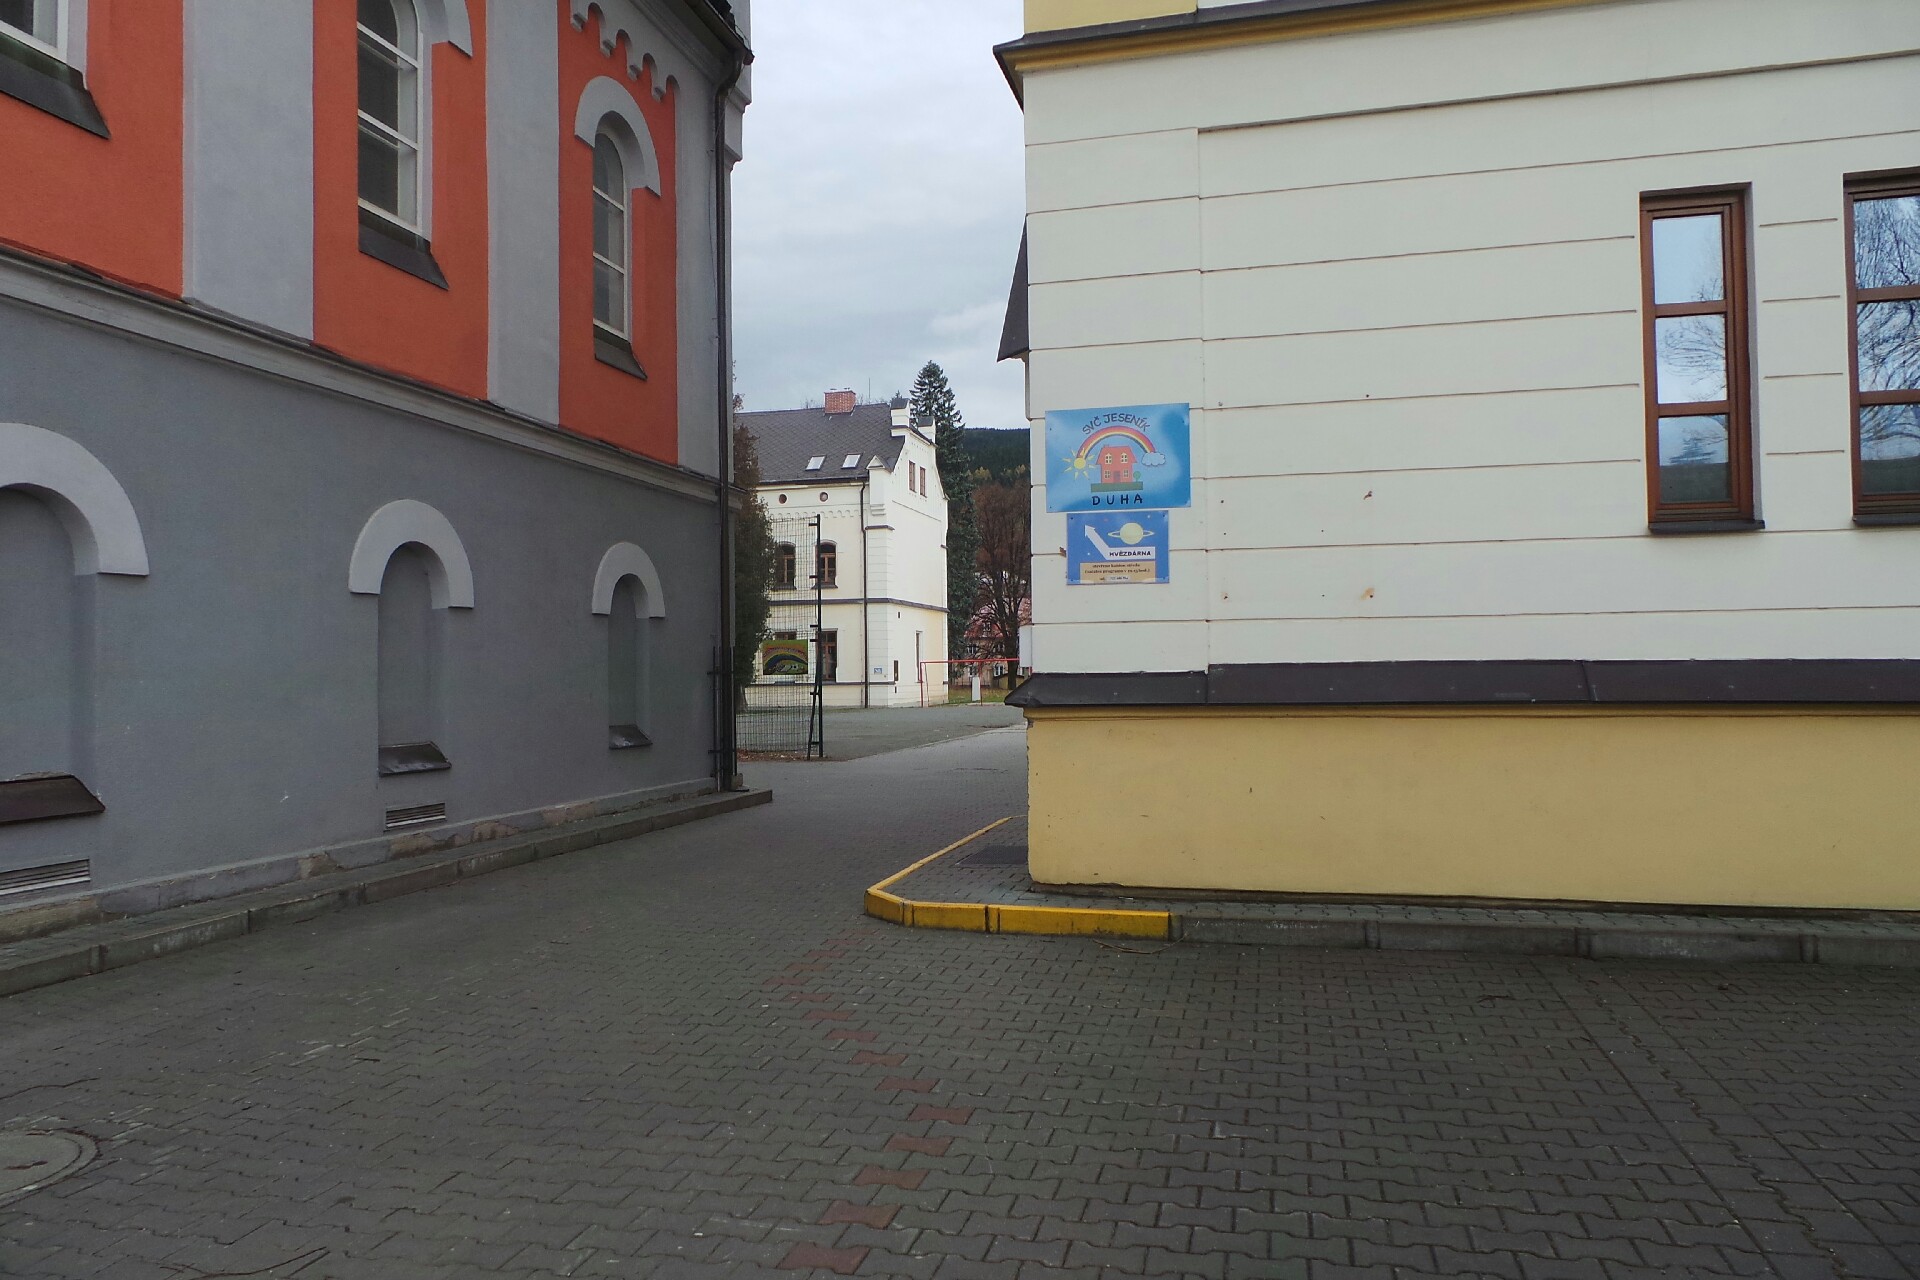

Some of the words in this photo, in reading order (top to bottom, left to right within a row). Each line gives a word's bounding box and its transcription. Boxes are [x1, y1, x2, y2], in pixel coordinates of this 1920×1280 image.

[1082, 415, 1101, 434] SVČ
[1103, 413, 1150, 432] JESENÍK
[1092, 493, 1143, 506] DUHA
